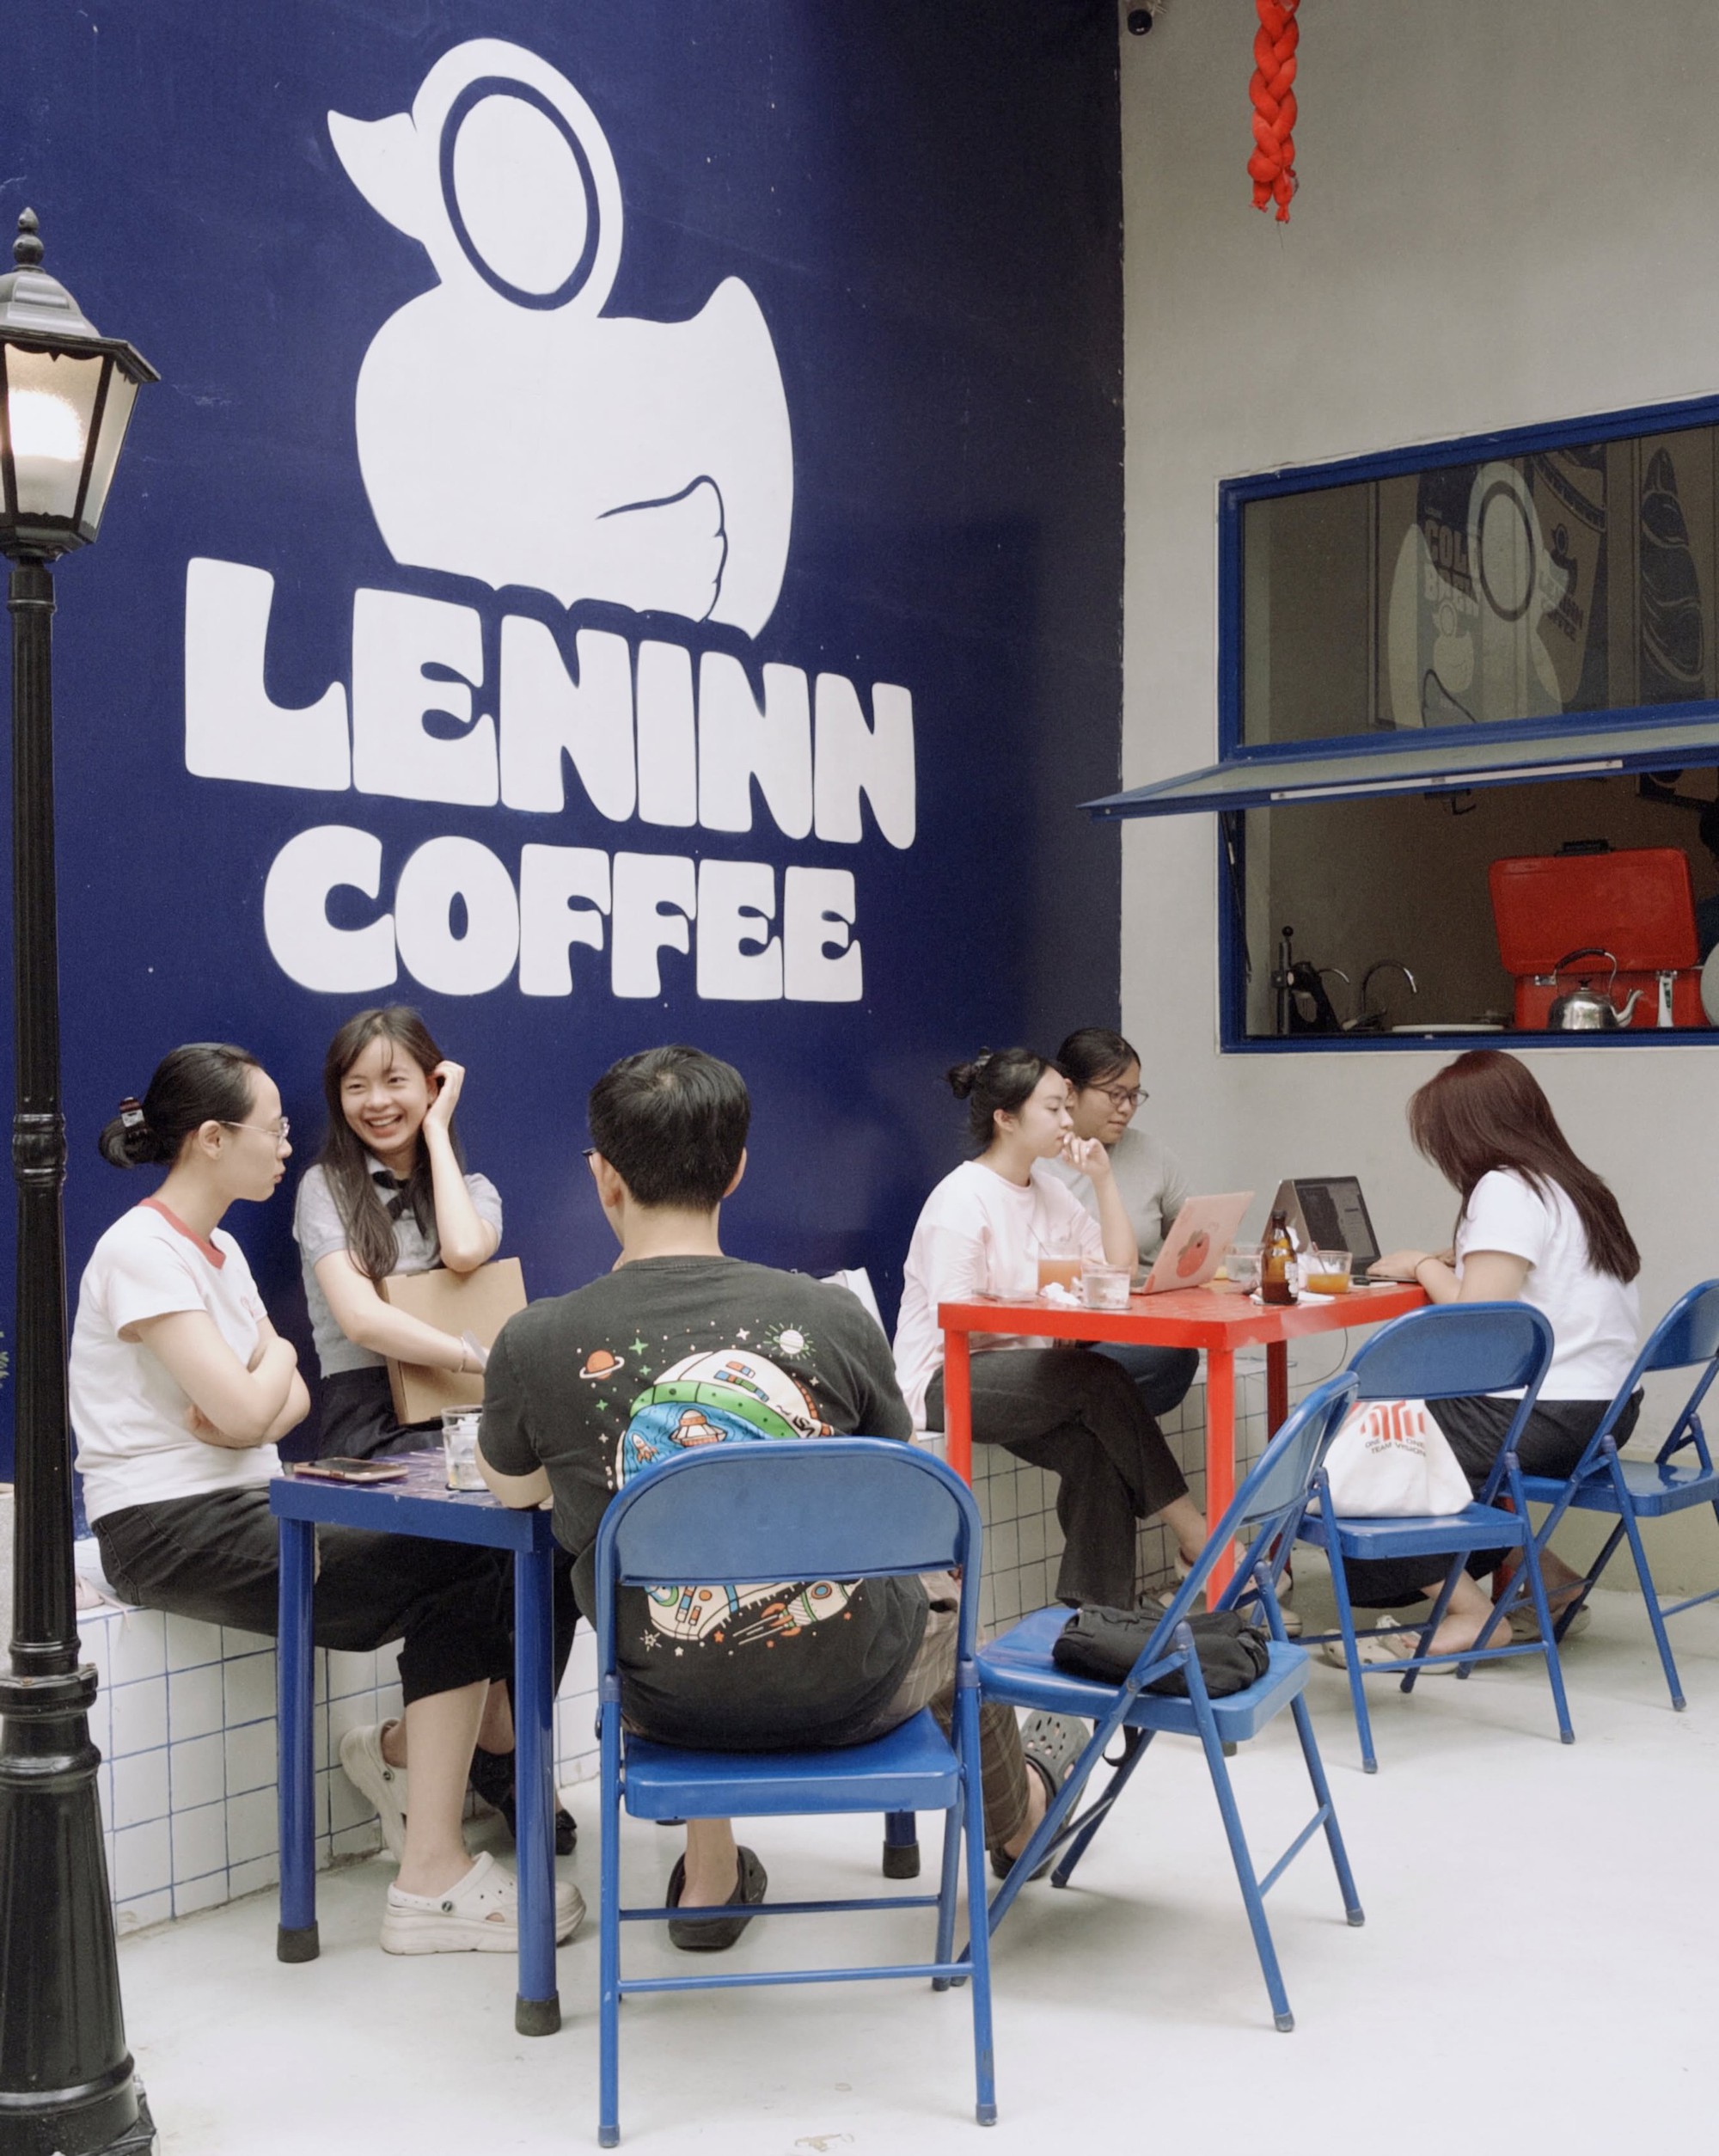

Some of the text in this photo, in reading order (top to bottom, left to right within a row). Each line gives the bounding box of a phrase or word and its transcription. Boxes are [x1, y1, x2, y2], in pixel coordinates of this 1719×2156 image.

[185, 556, 916, 850] LENINN
[264, 825, 863, 1001] COFFEE
[1371, 1442, 1392, 1454] TEAM
[1395, 1442, 1427, 1457] VISION
